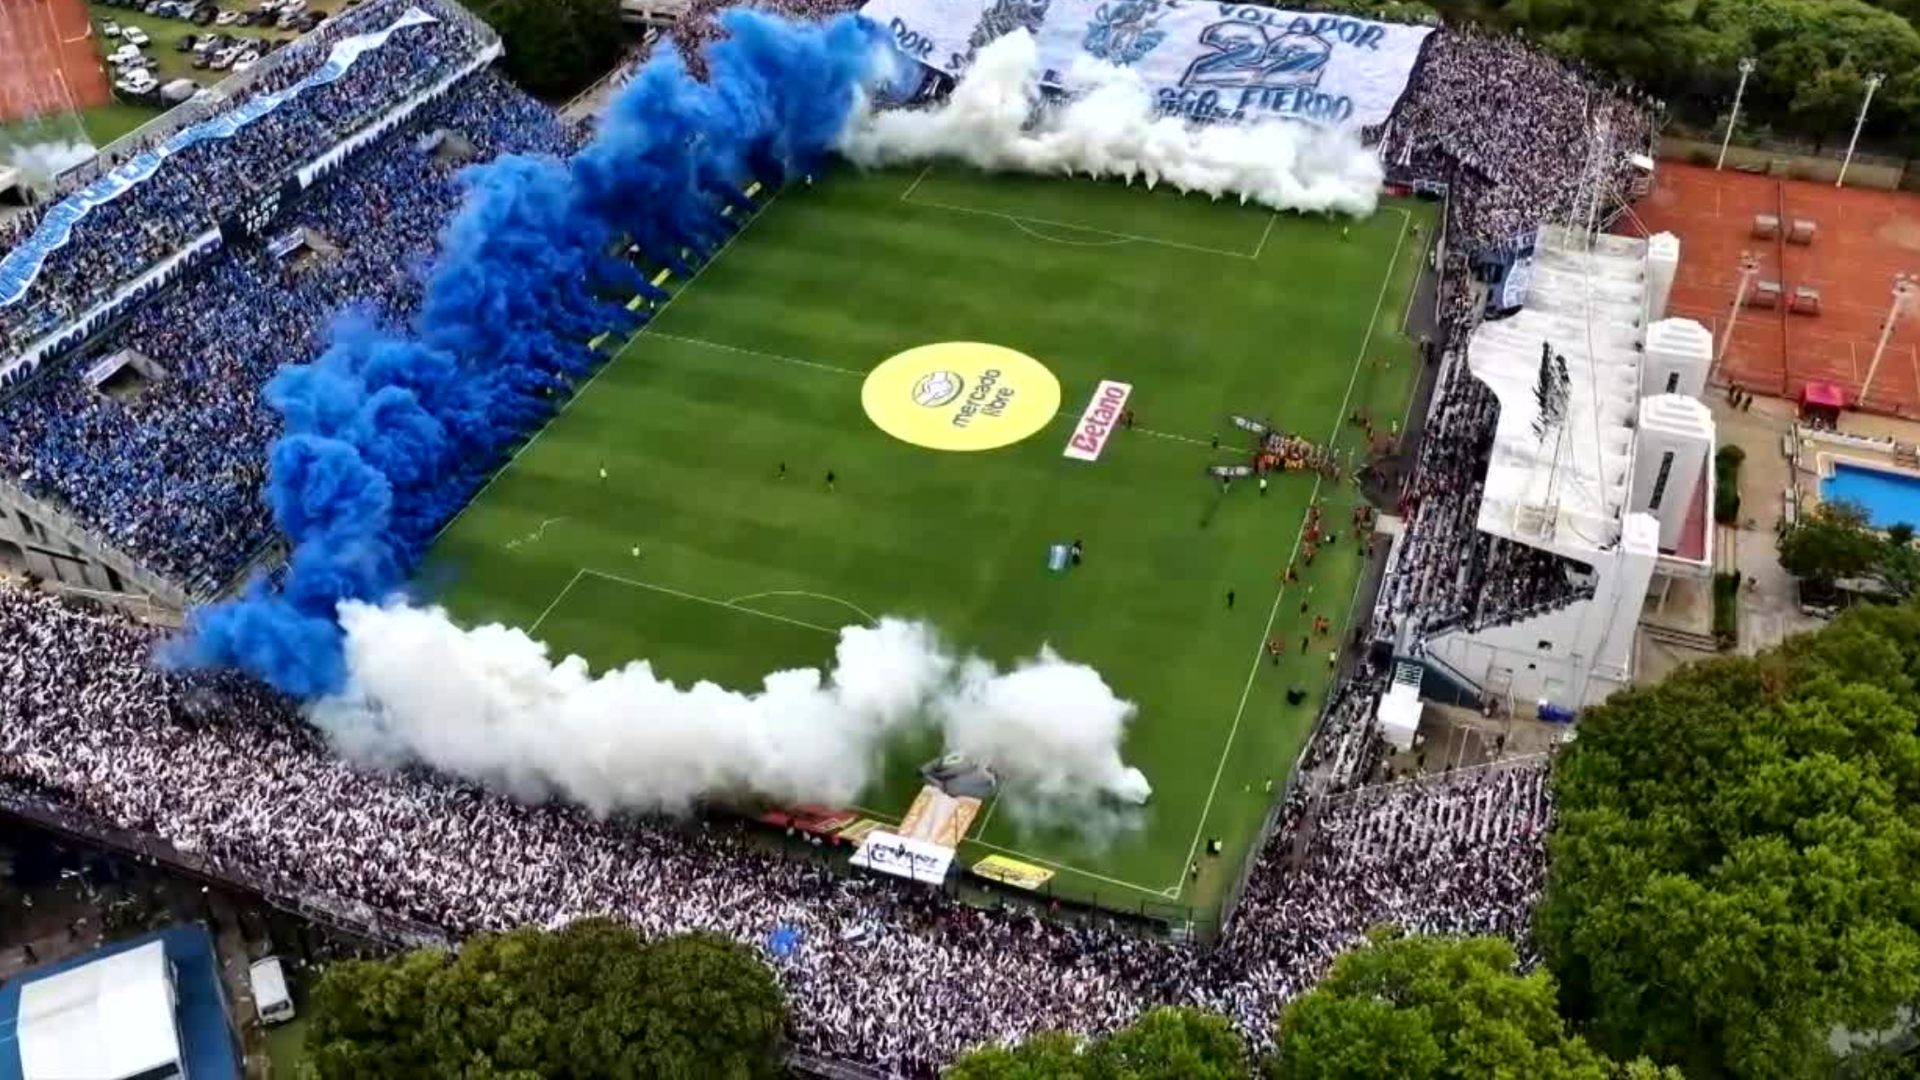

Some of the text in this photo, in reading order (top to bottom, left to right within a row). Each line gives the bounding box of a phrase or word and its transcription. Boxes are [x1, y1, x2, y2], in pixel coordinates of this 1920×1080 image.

[1178, 19, 1333, 88] 22
[951, 368, 1002, 429] mercado
[979, 385, 1015, 418] libre
[1071, 384, 1126, 455] Betano
